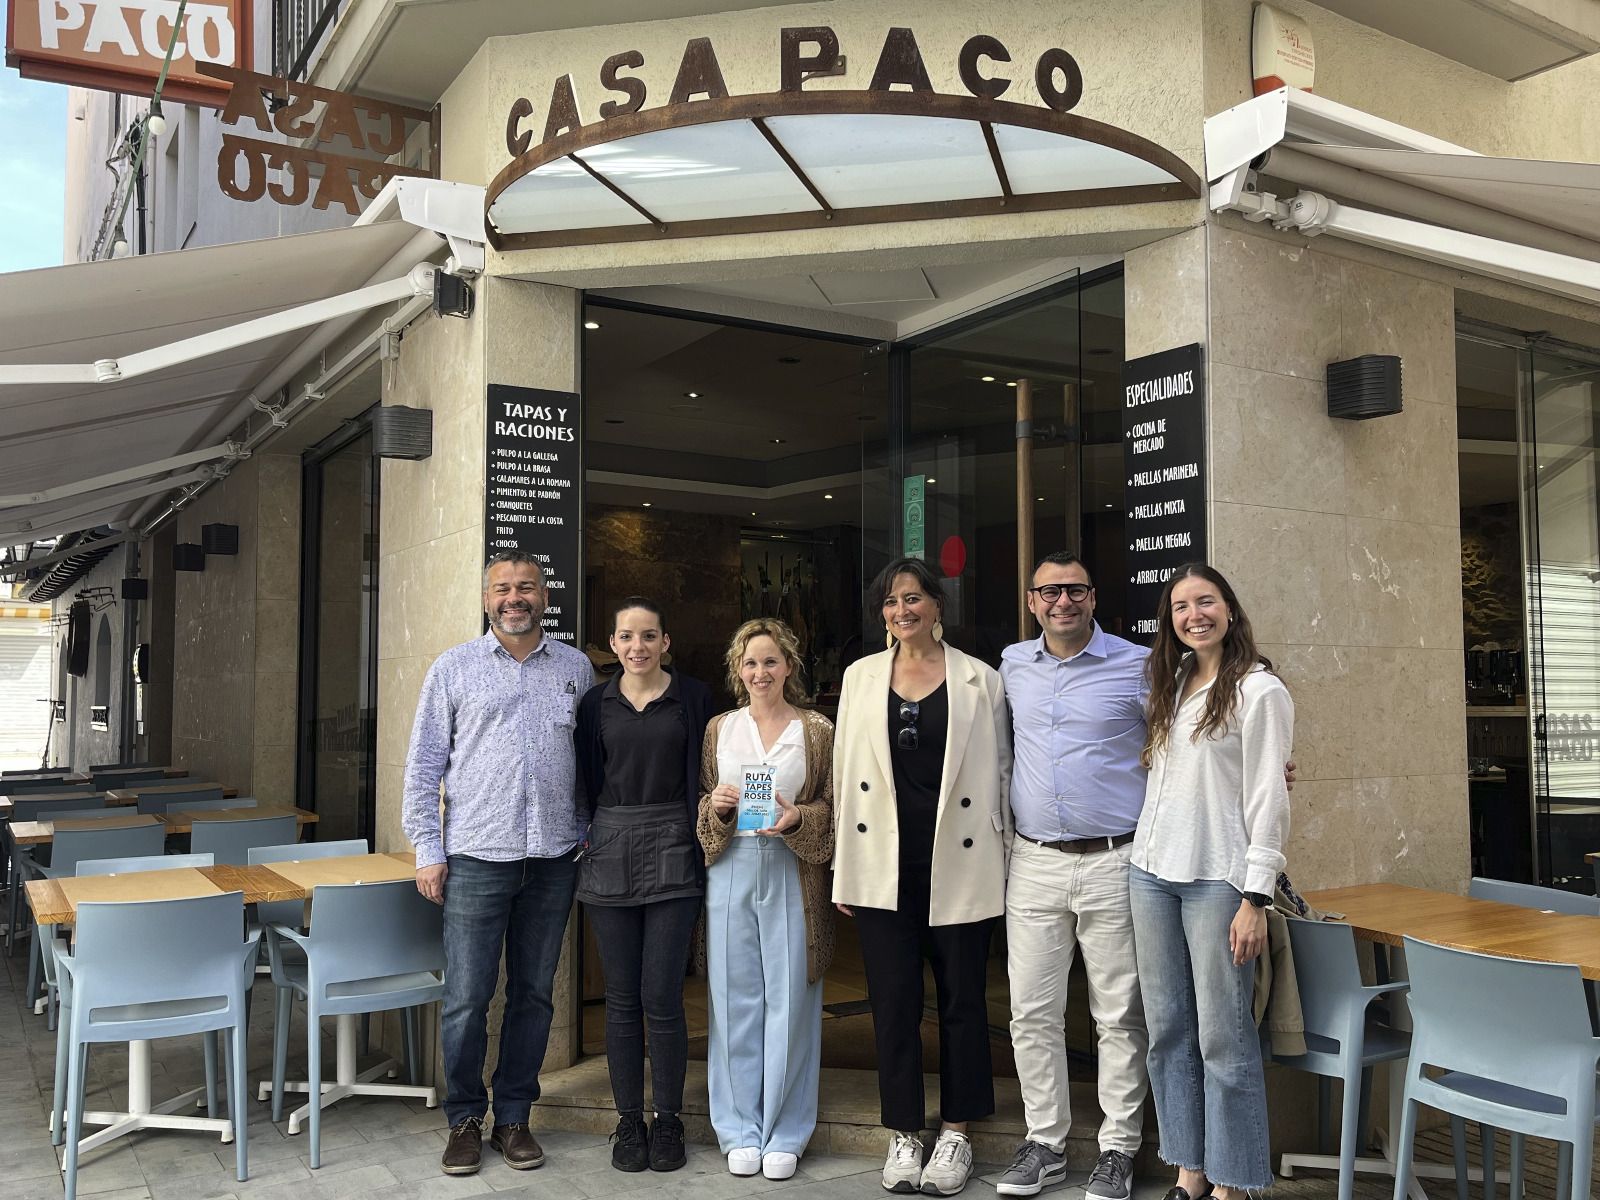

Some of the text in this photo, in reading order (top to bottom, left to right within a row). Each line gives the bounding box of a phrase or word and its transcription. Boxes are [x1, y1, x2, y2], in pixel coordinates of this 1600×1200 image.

[38, 0, 236, 67] PACO
[506, 26, 1083, 158] CASA PACO
[1126, 369, 1194, 408] ESPECIALIDADES
[502, 402, 568, 422] TAPAS Y
[495, 421, 575, 442] RACIONES
[1132, 418, 1167, 438] COCINA DE
[1133, 436, 1164, 454] MERCADO
[497, 448, 516, 458] PULPO
[523, 451, 531, 459] LA
[532, 452, 559, 461] GALLEGA
[496, 462, 516, 470] PULPO
[523, 463, 531, 472] LA
[532, 464, 551, 474] BRASA
[1134, 462, 1199, 487] PAELLAS MARINERA
[496, 474, 530, 485] CALAMARES
[537, 478, 545, 486] LA
[546, 478, 571, 488] ROMANA
[496, 487, 561, 500] PIMIENTOS DE PADRÓN
[496, 500, 533, 511] CHANQUETES
[1135, 499, 1185, 520] PAELLAS MIXTA
[496, 513, 564, 526] PESCADITO DE LA COSTA
[496, 526, 514, 535] FRITO
[495, 540, 518, 549] CHOCOS
[1135, 531, 1192, 552] PAELLAS NEGRAS
[1136, 569, 1159, 585] ARROZ
[546, 580, 566, 589] ANCHA
[746, 772, 772, 781] RUTA
[745, 783, 772, 791] TAPES
[744, 792, 772, 800] ROSES
